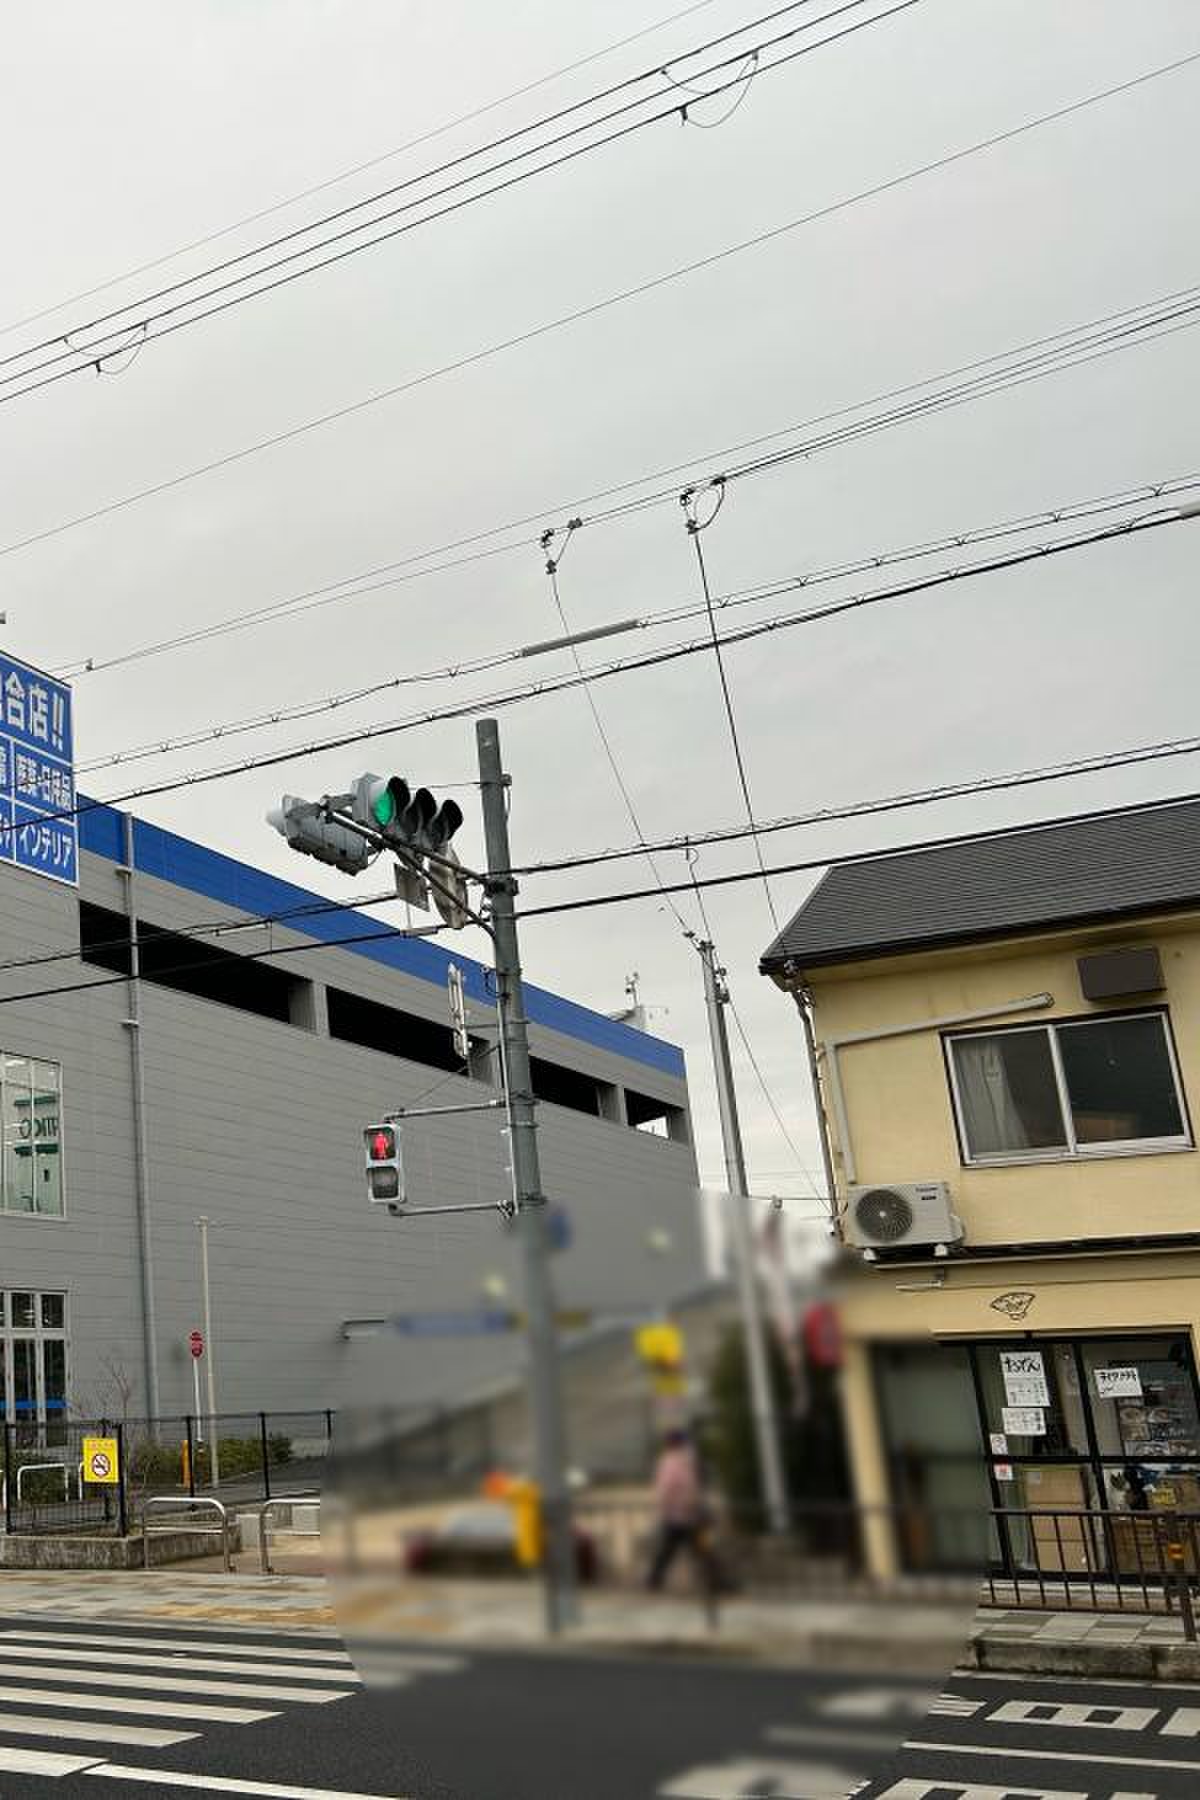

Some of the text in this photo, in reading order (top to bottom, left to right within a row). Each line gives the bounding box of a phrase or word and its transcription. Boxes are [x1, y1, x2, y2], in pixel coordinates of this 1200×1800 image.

[20, 824, 72, 868] インテリア
